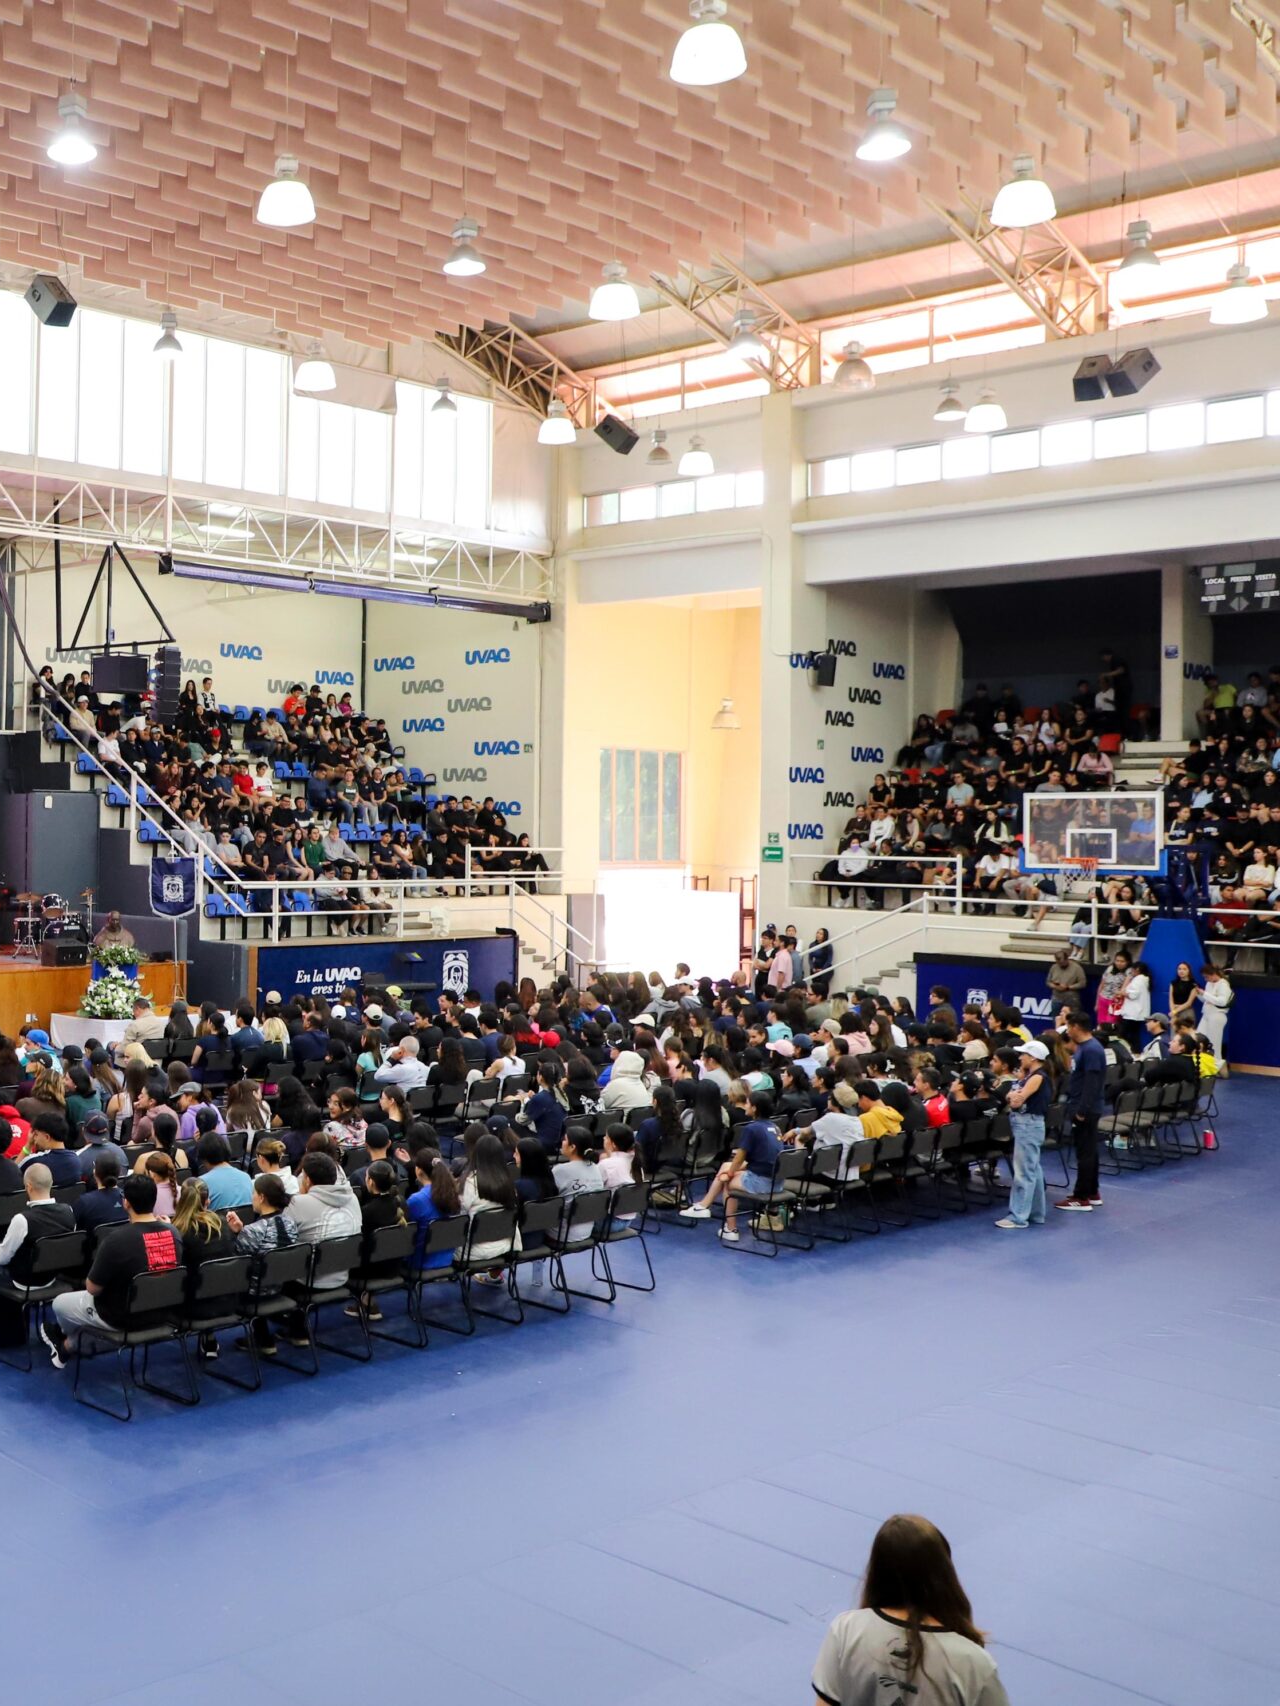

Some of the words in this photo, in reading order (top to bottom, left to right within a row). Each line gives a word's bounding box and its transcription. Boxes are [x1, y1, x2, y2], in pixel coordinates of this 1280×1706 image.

[1204, 577, 1226, 585] LOCAL
[220, 643, 262, 661] UVAQ
[465, 648, 511, 665] UVAQ
[180, 658, 212, 674] VAQ
[374, 655, 415, 672] UVAQ
[873, 662, 905, 680] UVAQ
[315, 670, 354, 686] UVAQ
[402, 679, 444, 695] UVAQ
[849, 686, 881, 705] UVAQ
[448, 696, 492, 713] UVAQ
[402, 717, 445, 733] UVAQ
[474, 740, 520, 756] UVAQ
[851, 746, 884, 763] UVAQ
[443, 767, 487, 782] UVAQ
[789, 767, 824, 783] UVAQ
[788, 823, 823, 840] UVAQ
[295, 970, 311, 983] En
[313, 969, 323, 982] la
[311, 985, 333, 995] eres
[335, 981, 346, 993] tú
